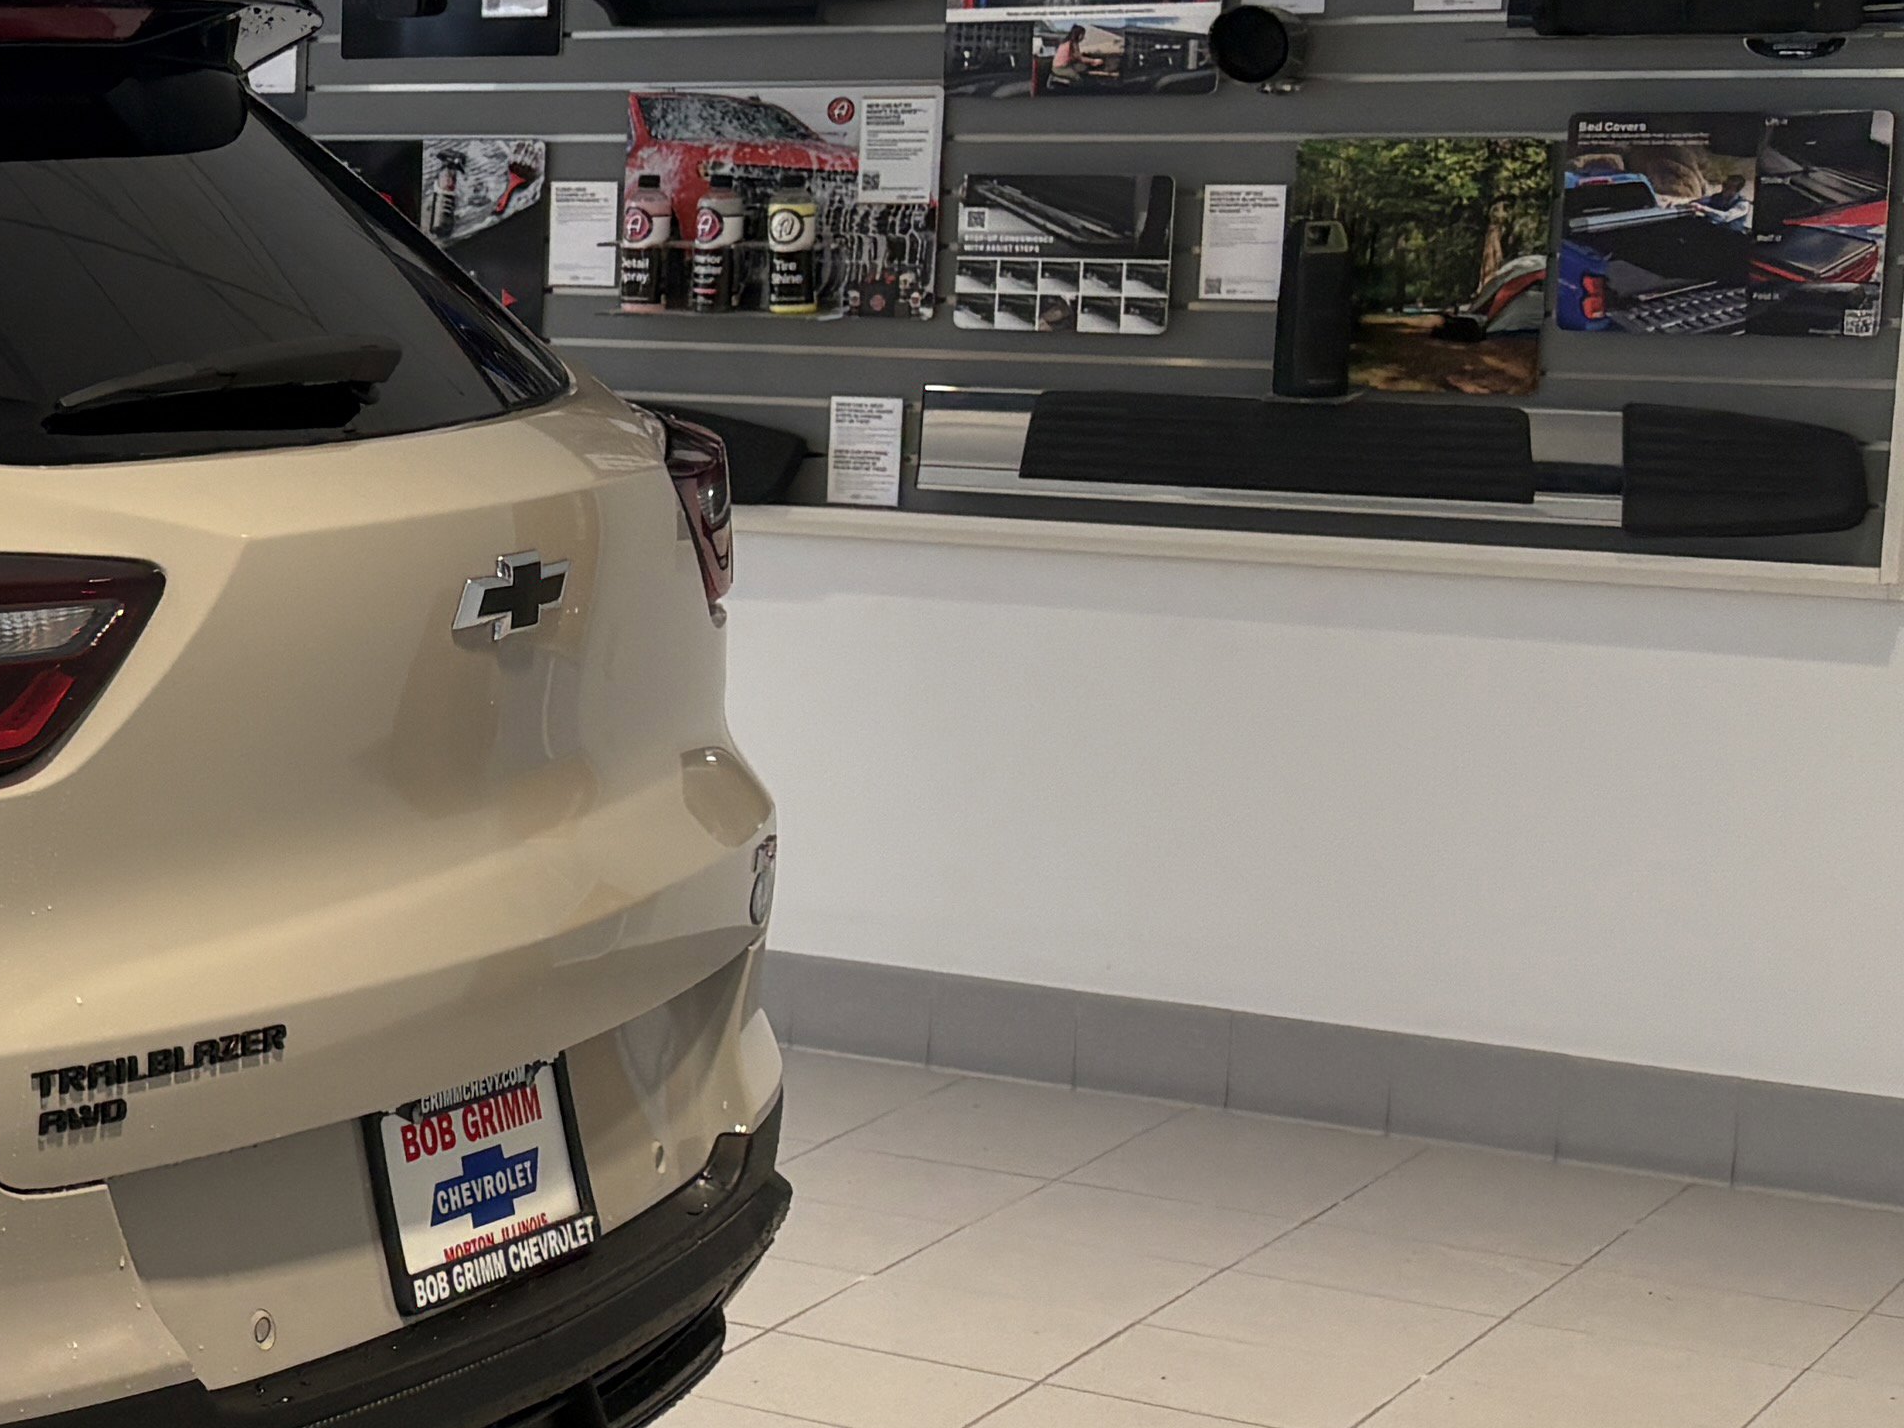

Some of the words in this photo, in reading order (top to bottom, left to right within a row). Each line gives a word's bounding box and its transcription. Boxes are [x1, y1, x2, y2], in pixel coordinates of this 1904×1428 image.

[1578, 121, 1603, 132] Bed
[1604, 121, 1647, 132] Covers
[31, 1024, 288, 1099] TRAILBLAZER
[38, 1098, 128, 1136] AWD
[401, 1114, 457, 1163] BOB
[462, 1084, 543, 1143] GRIMM
[436, 1161, 534, 1215] CHEVROLET
[414, 1272, 450, 1309] BOB
[452, 1248, 507, 1293] GRIMM
[509, 1216, 596, 1272] CHEVROLET
